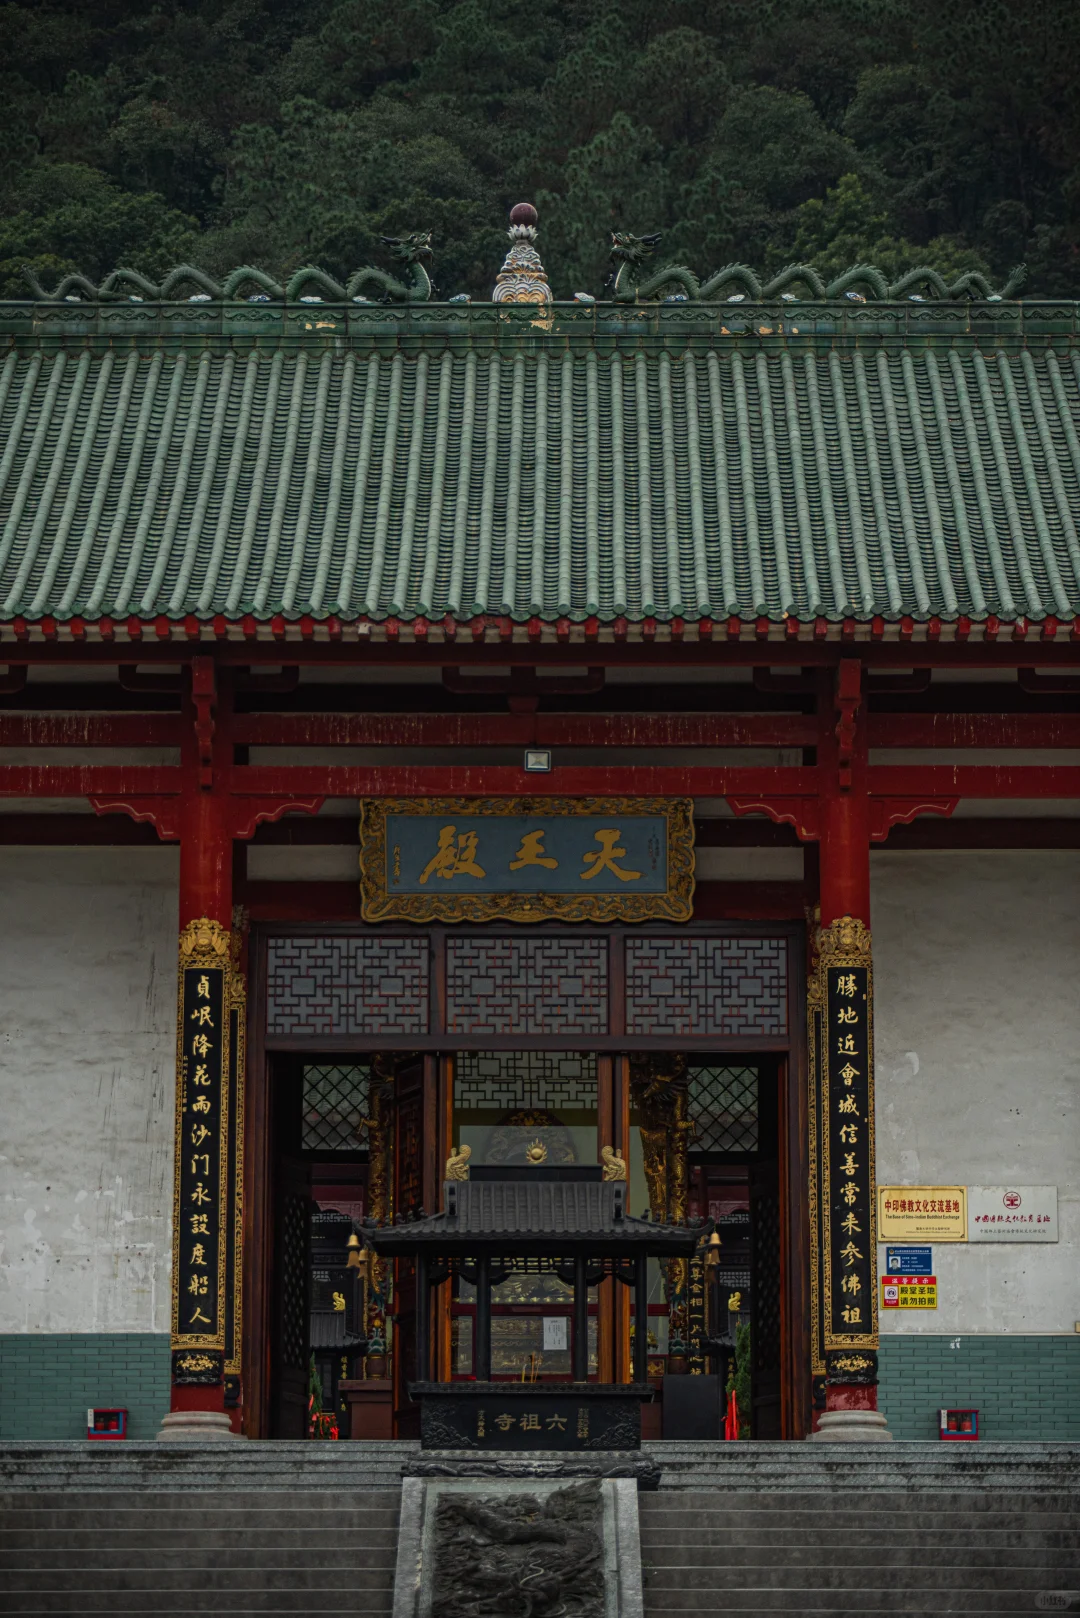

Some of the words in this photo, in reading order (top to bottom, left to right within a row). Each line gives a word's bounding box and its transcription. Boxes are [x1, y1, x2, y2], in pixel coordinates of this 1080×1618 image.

[419, 825, 646, 884] 天王殿
[884, 1199, 960, 1213] 中印佛教文化交流基地
[900, 1286, 936, 1295] 殿堂圣地
[900, 1297, 936, 1306] 请勿拍照
[689, 1256, 705, 1375] 三尊金相一片
[494, 1413, 568, 1431] 六祖寺
